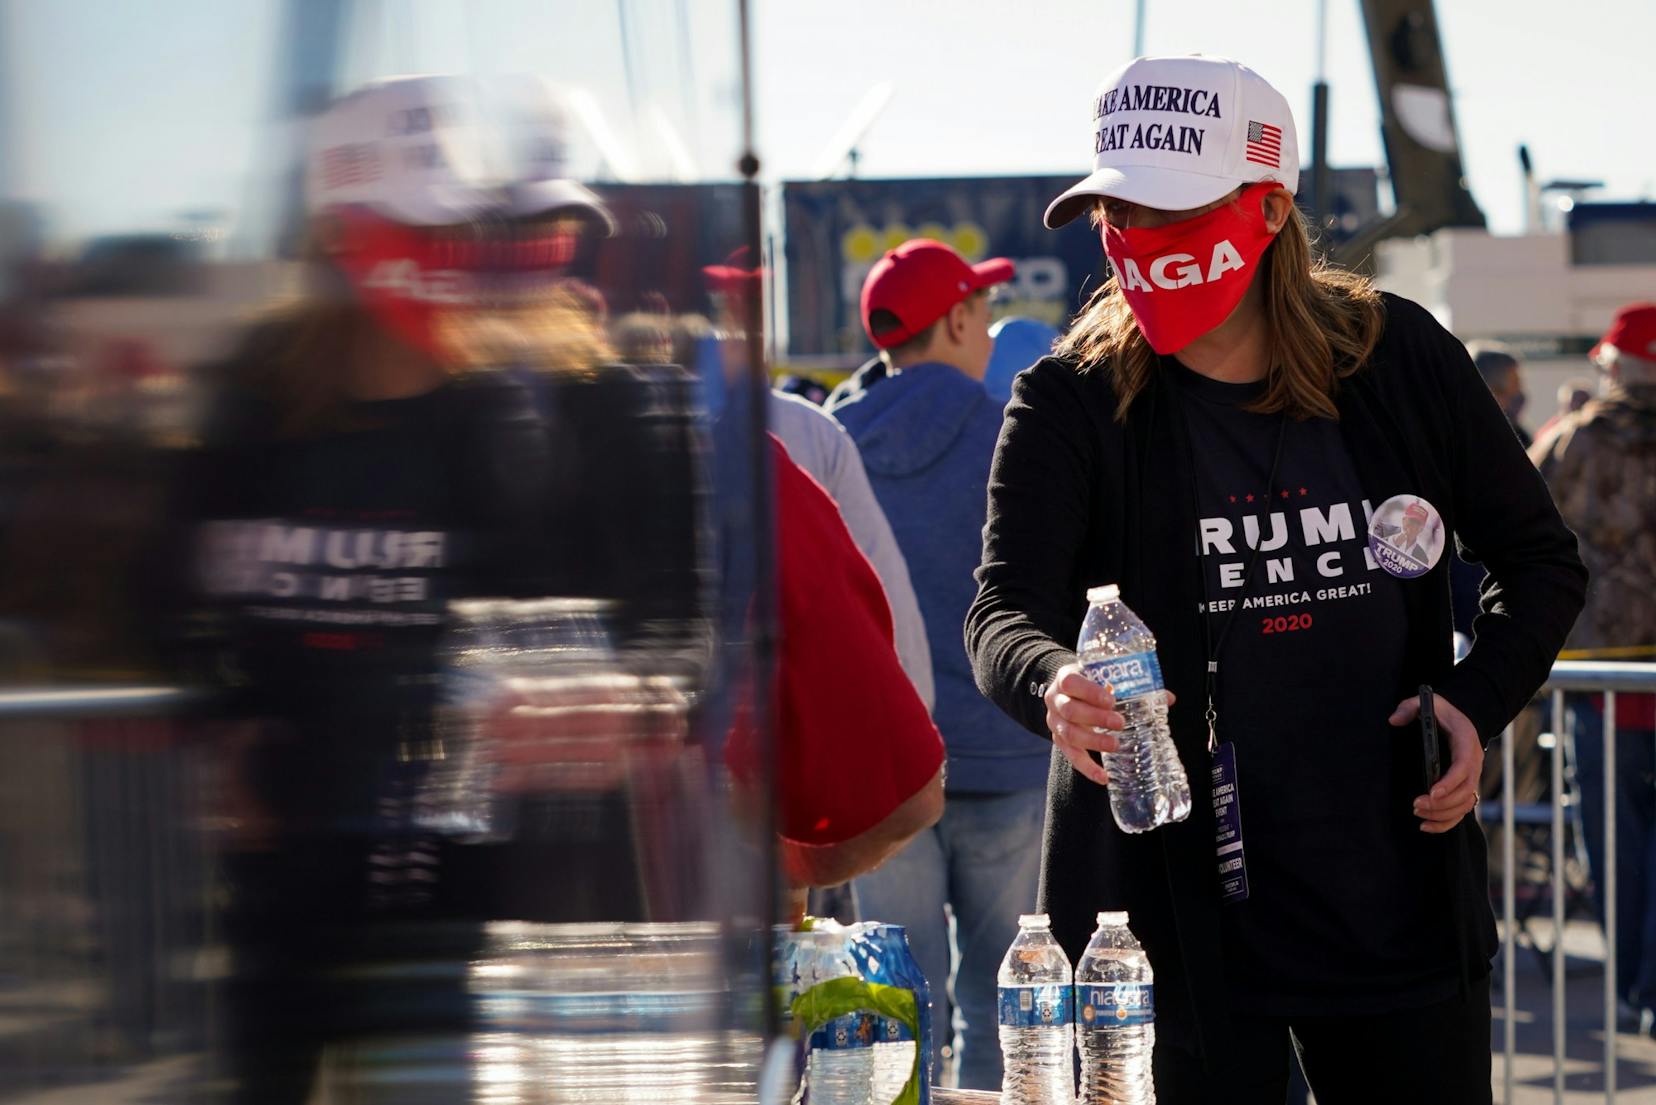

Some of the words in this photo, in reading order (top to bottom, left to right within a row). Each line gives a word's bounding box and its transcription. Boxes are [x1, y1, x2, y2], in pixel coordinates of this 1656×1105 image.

[1093, 88, 1118, 121] AKE
[1117, 85, 1221, 119] AMERICA
[1095, 123, 1130, 154] REAT
[1130, 124, 1204, 156] AGAIN
[1195, 499, 1375, 556] RUM
[1219, 546, 1382, 588] ENC
[1376, 543, 1418, 571] TRUMP
[1383, 558, 1403, 574] 2020
[1242, 590, 1311, 610] AMERICA
[1316, 582, 1372, 601] GREAT!
[1262, 613, 1313, 634] 2020
[1218, 857, 1243, 875] OLUNTEER
